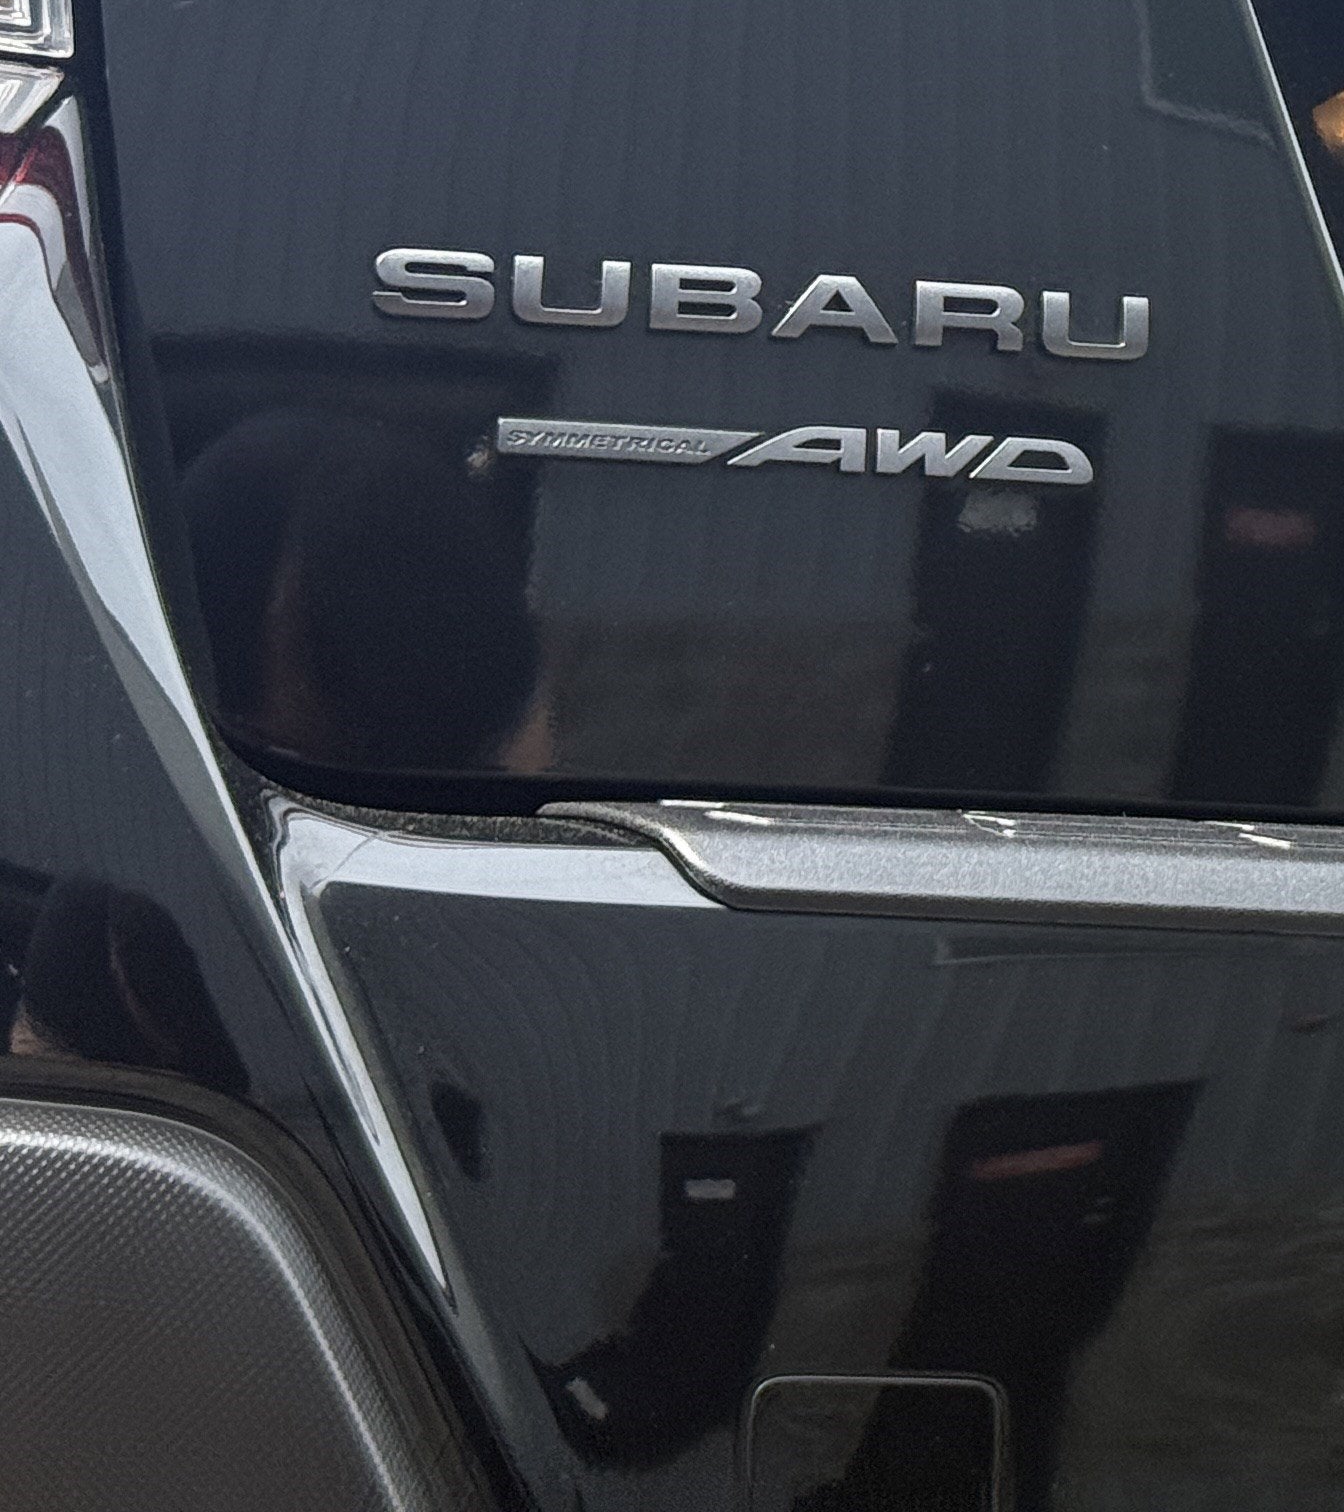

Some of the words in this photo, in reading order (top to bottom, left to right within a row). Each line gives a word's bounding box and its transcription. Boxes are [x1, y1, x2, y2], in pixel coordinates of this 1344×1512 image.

[372, 247, 1149, 361] SUBARU
[506, 428, 712, 457] SYMMETRICAL
[727, 426, 1094, 485] AWD
